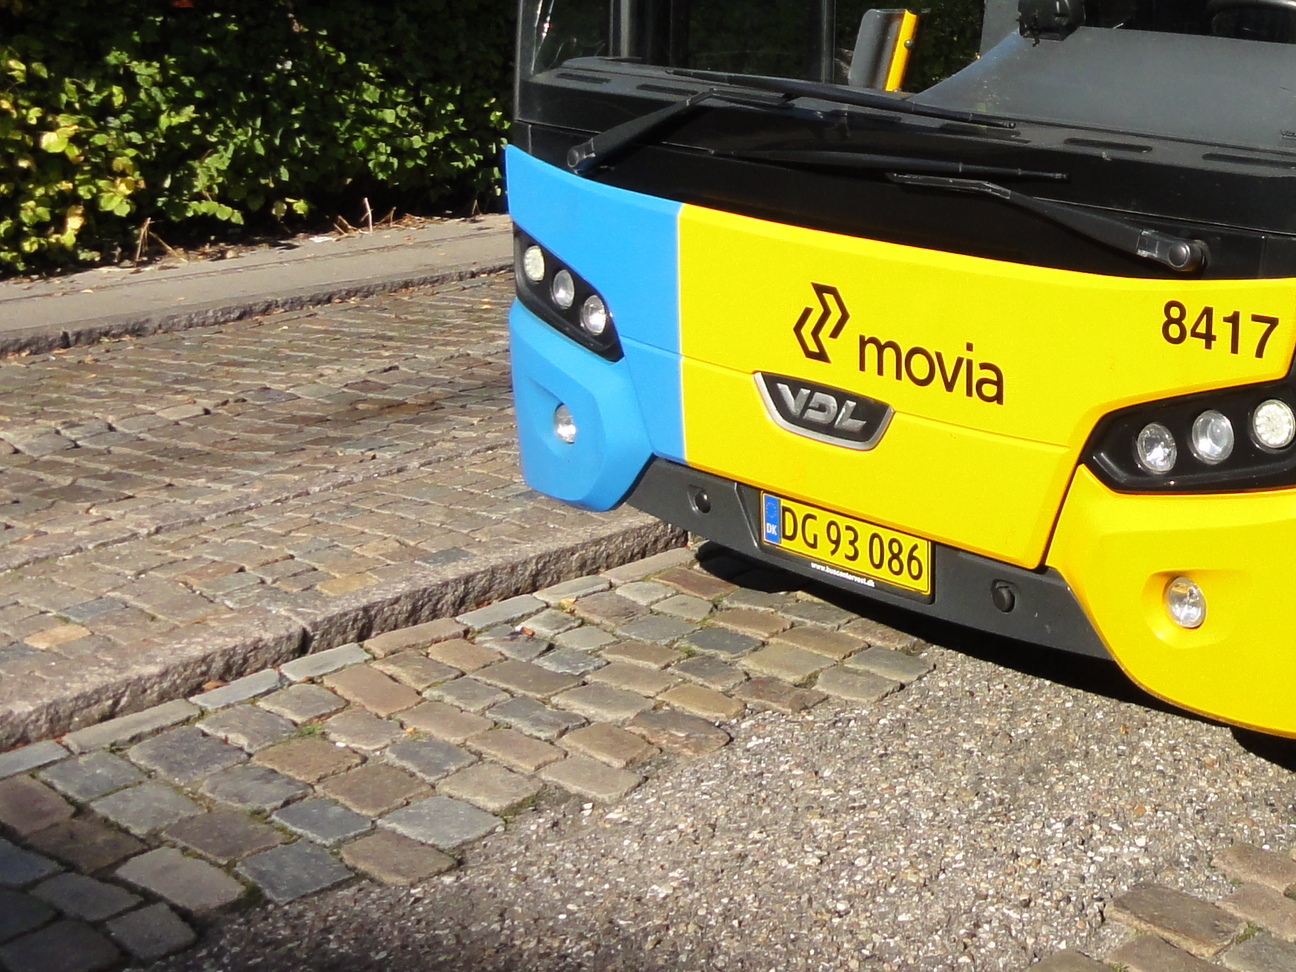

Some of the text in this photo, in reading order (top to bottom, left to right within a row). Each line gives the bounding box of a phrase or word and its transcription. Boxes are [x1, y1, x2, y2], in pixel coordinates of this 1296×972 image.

[1162, 299, 1280, 359] 8417
[858, 333, 1005, 406] movia
[776, 382, 867, 432] VDL
[766, 522, 778, 536] DK
[781, 505, 924, 581] DG 93 086
